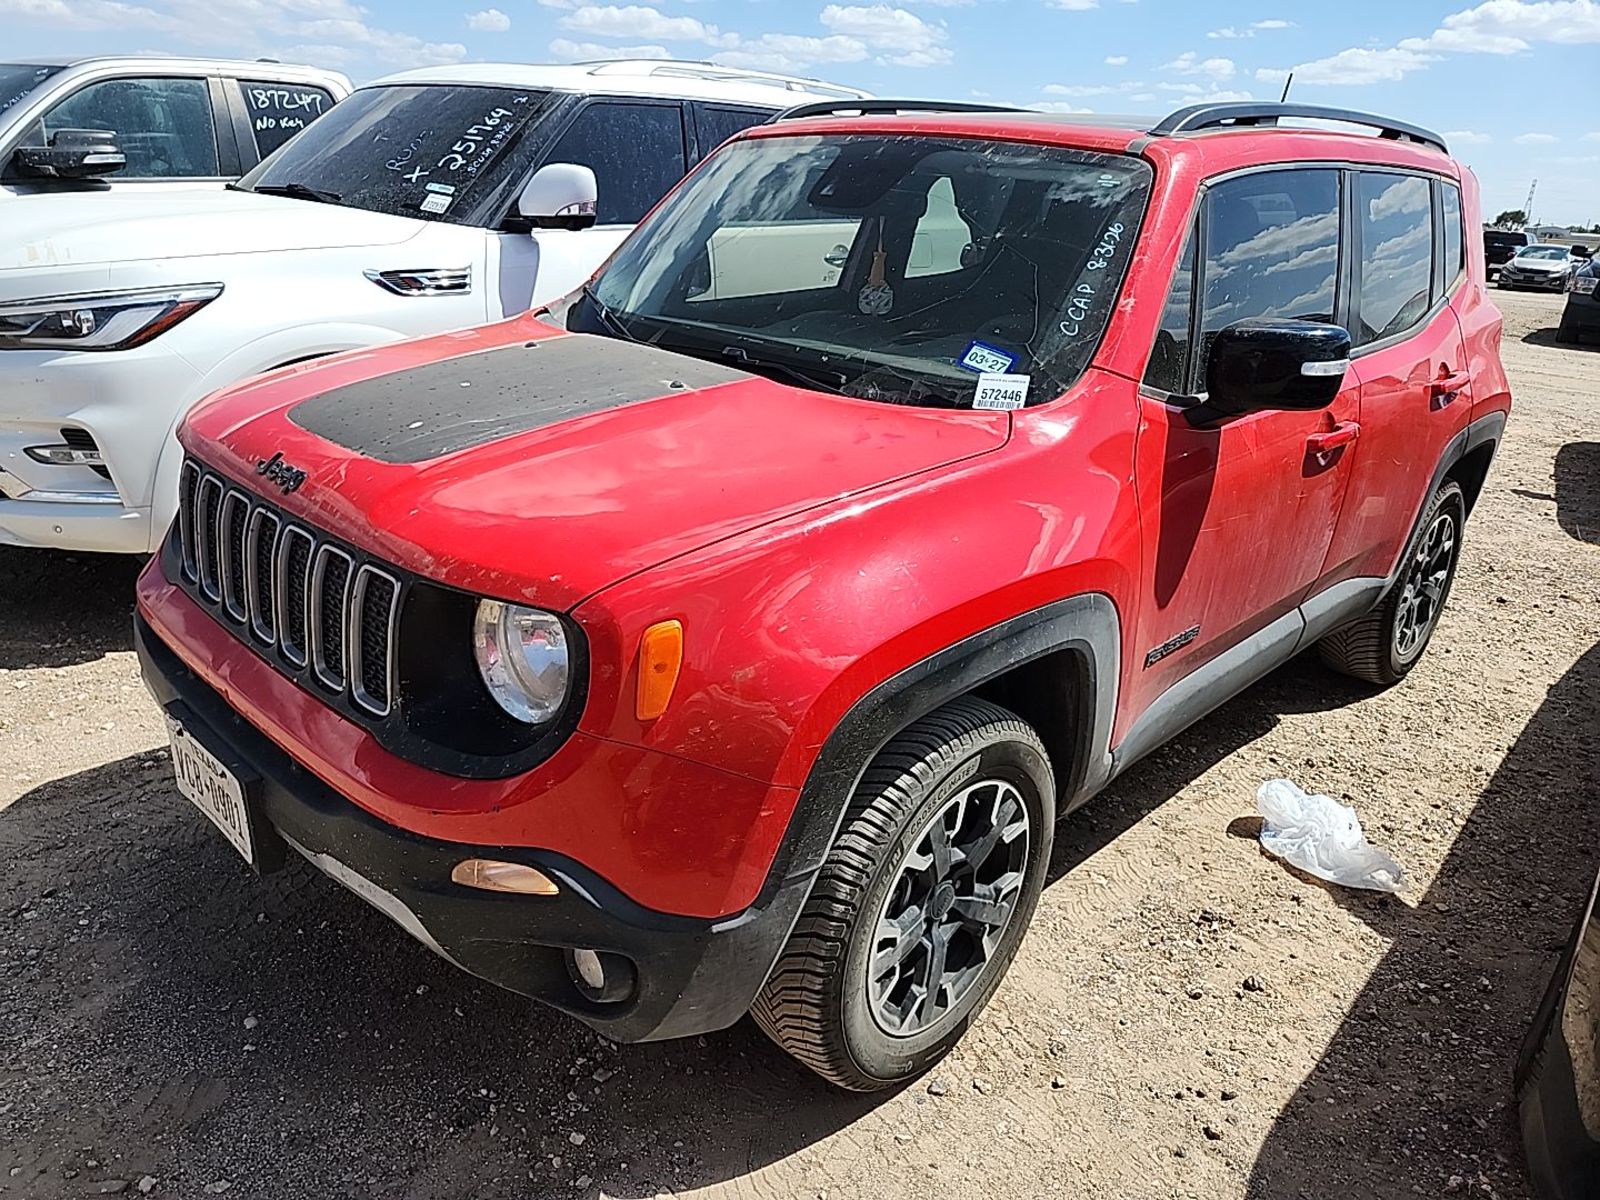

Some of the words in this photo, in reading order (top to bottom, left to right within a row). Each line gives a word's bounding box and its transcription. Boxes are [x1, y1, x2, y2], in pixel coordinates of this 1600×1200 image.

[437, 107, 513, 171] 251764
[1060, 284, 1096, 336] CCAP
[980, 388, 1022, 402] 572446
[257, 451, 308, 496] Jeep
